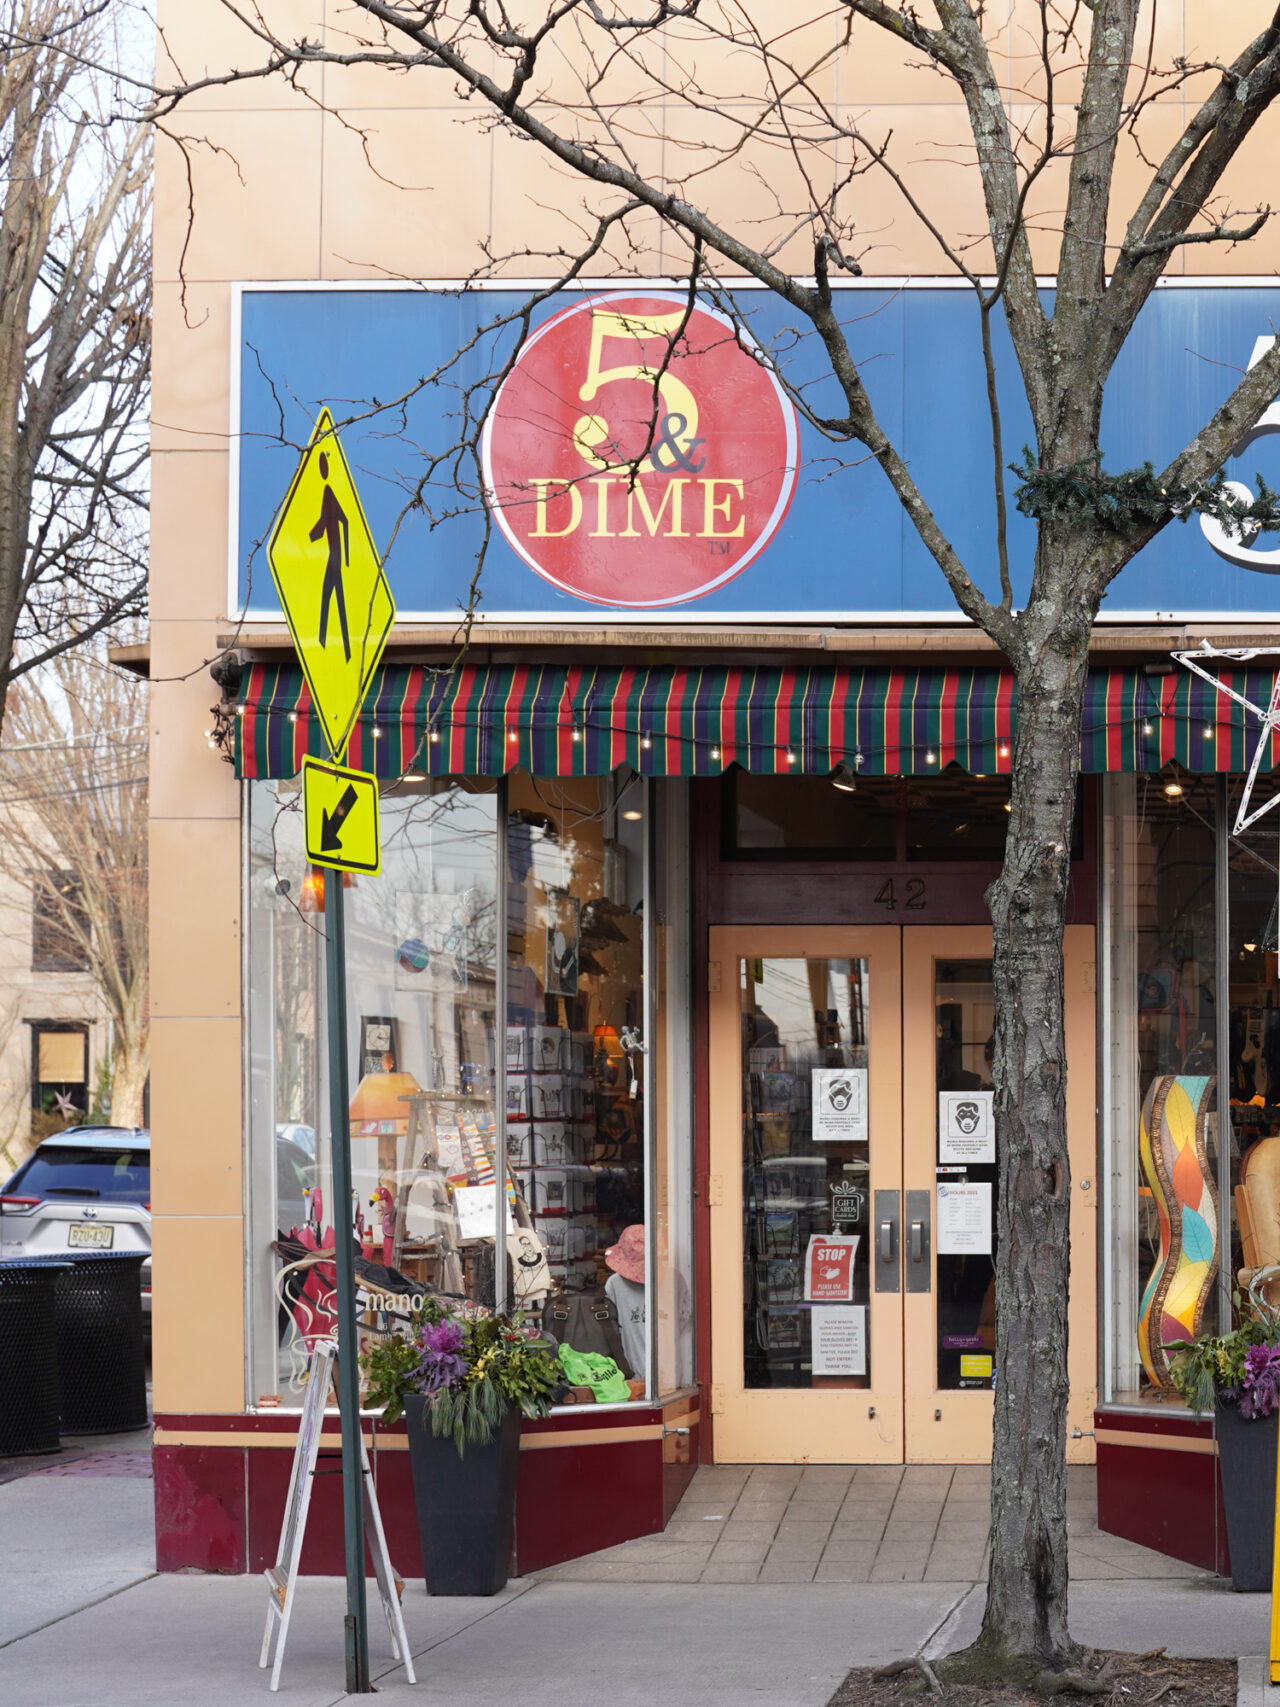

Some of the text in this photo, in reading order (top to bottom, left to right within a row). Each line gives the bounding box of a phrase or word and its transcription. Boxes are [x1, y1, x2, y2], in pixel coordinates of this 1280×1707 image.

[573, 308, 699, 475] 5
[649, 411, 707, 475] &
[527, 478, 747, 538] DIME
[707, 541, 731, 556] TM
[873, 877, 927, 910] 42
[817, 1248, 847, 1261] STOP
[365, 1292, 424, 1312] mano
